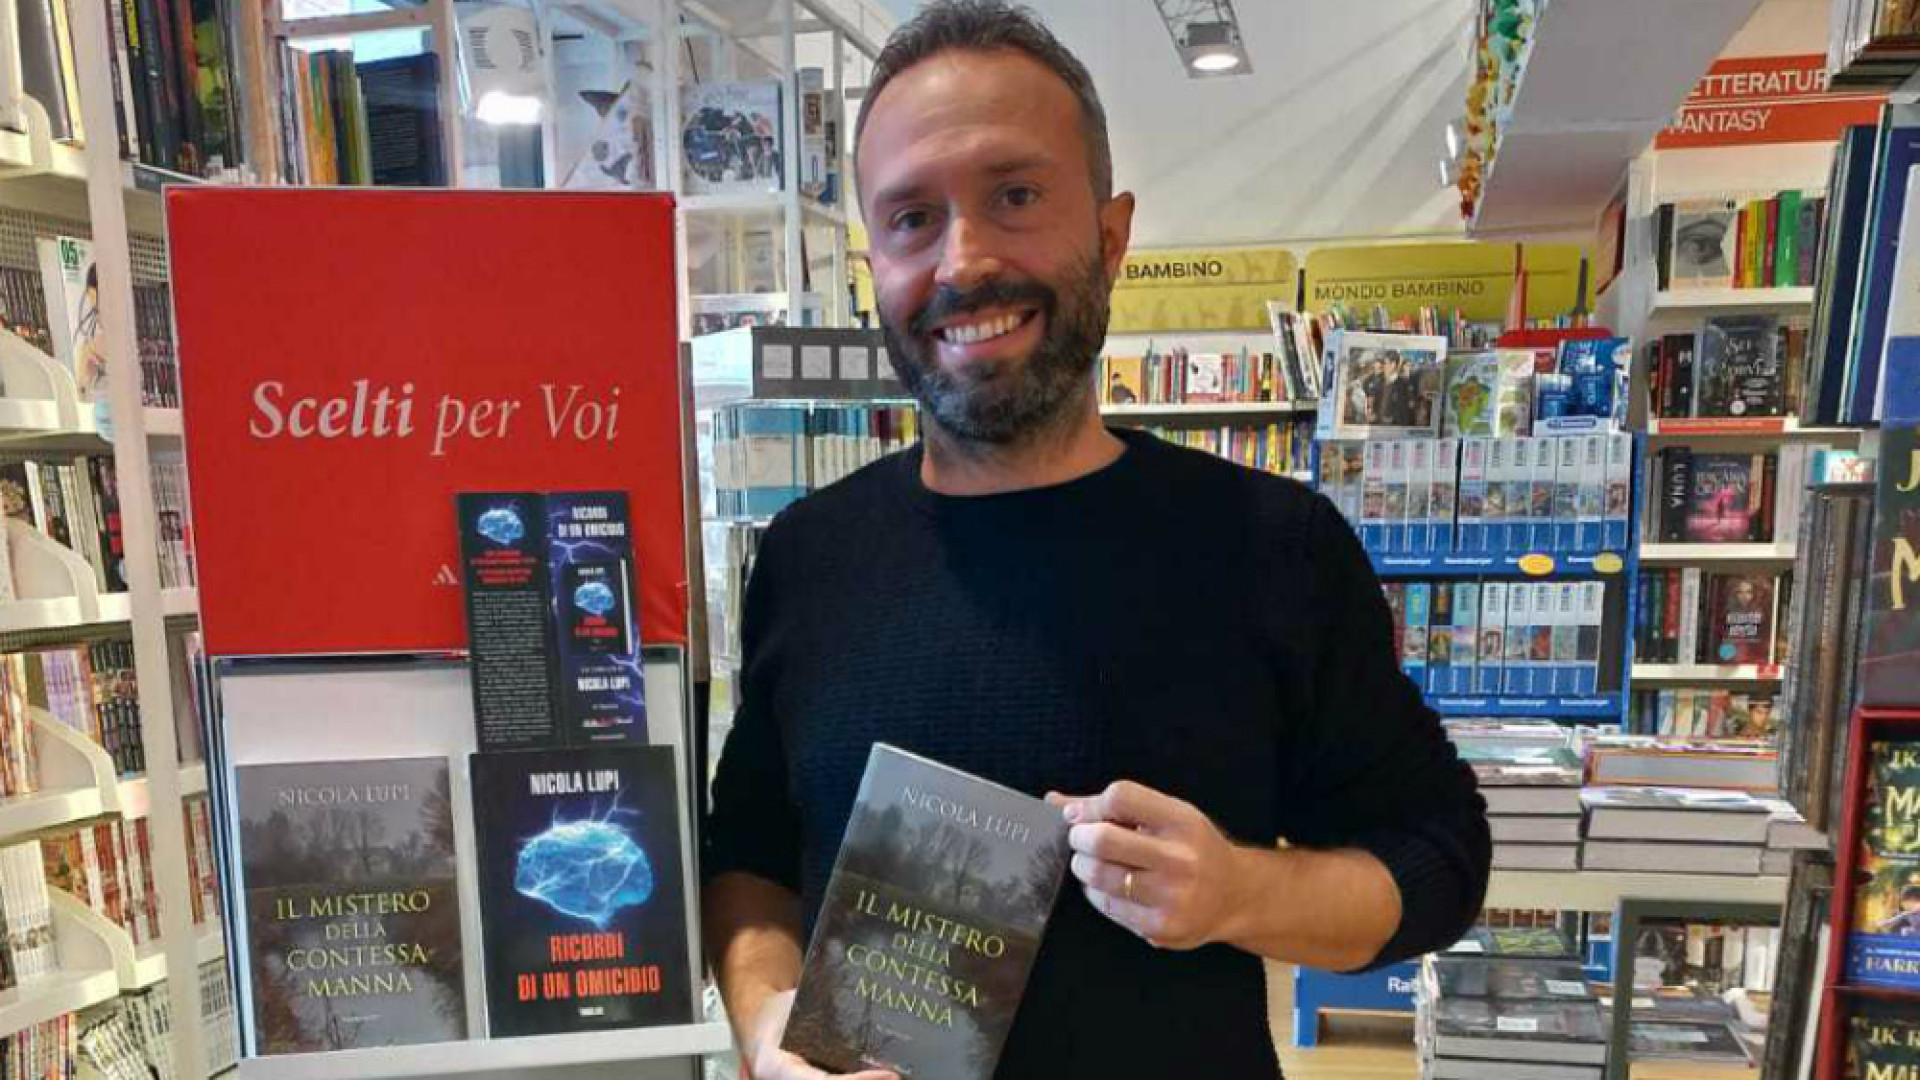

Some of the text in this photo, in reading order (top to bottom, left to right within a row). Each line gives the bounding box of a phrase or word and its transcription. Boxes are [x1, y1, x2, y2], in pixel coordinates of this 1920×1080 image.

[1669, 109, 1771, 135] ANTASY
[1126, 260, 1222, 278] BAMBINO
[1314, 279, 1485, 300] MONDO BAMBINO
[249, 379, 621, 456] Scelti per Voi
[279, 784, 410, 806] NICOLA LUPI
[531, 770, 619, 795] NICOLA LUPI
[902, 785, 1031, 844] NICOLA LUPI
[276, 890, 431, 920] IL MISTERO
[325, 922, 387, 940] DELLA
[855, 889, 1005, 958] IL MISTERO
[287, 943, 429, 972] CONTESSA
[549, 932, 625, 962] RICORDI
[892, 932, 950, 967] DELLA
[308, 972, 414, 998] MANNA
[517, 965, 662, 1001] DI UN OMICIDIO
[847, 943, 979, 1008] CONTESSA
[854, 977, 953, 1029] MANNA
